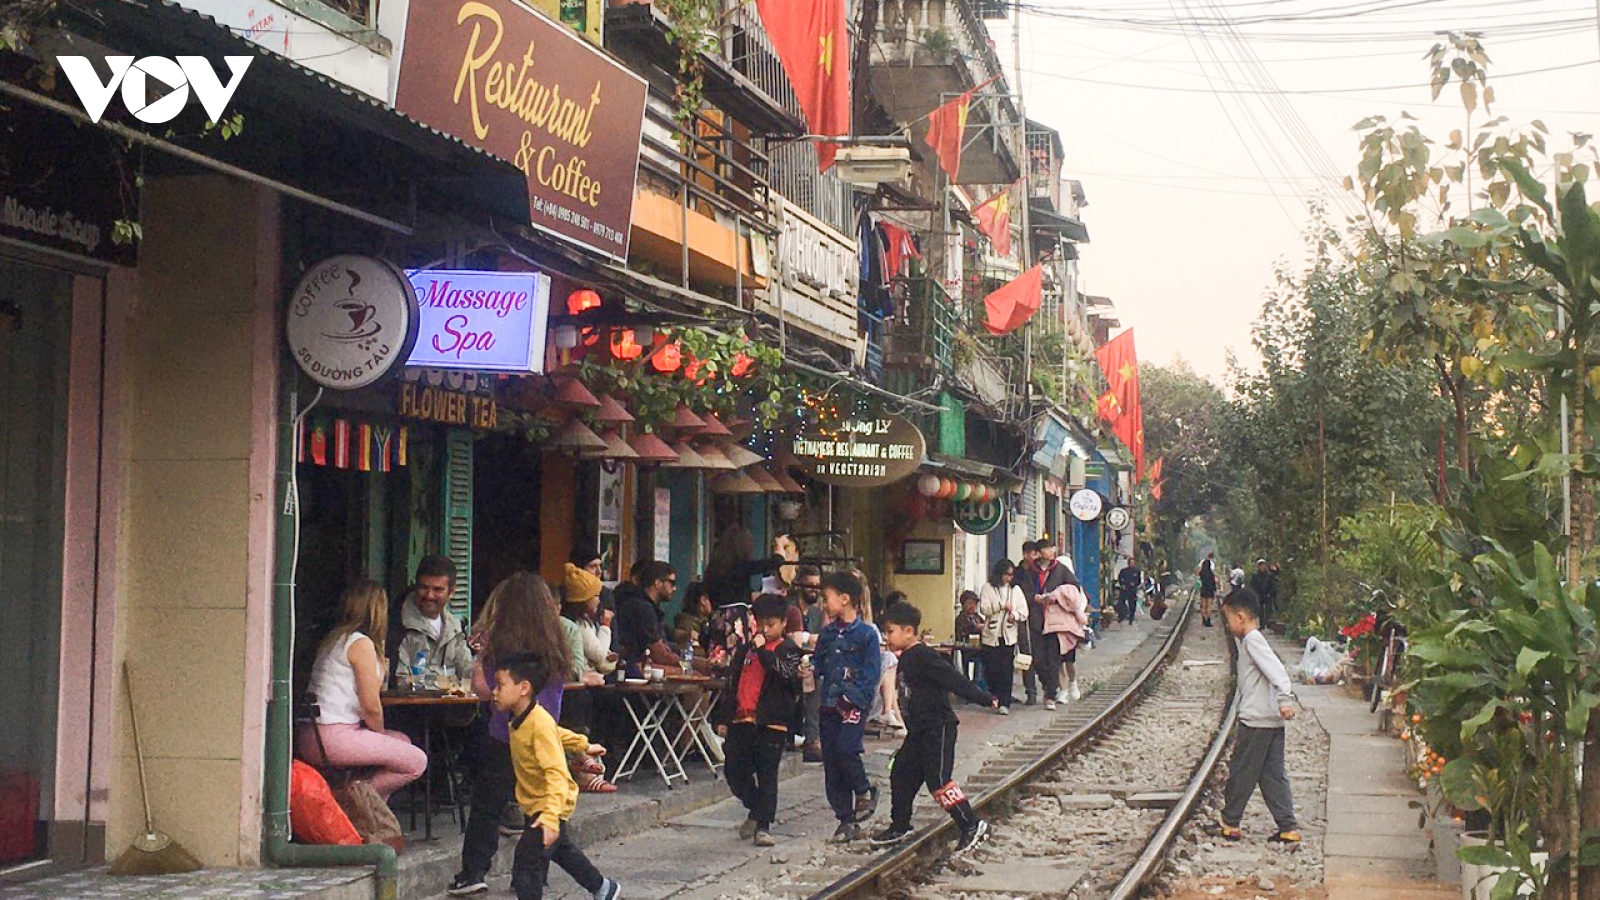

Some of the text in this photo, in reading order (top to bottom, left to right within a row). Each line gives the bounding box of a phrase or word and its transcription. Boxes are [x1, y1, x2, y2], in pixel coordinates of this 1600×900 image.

[453, 1, 601, 148] Restaurant
[514, 130, 602, 208] & Coffee
[414, 279, 528, 318] Massage
[432, 315, 497, 360] Spa
[400, 382, 497, 428] FLOWER TEA
[835, 441, 880, 459] RESAURANT
[880, 447, 888, 459] &
[888, 444, 915, 460] COFFEE
